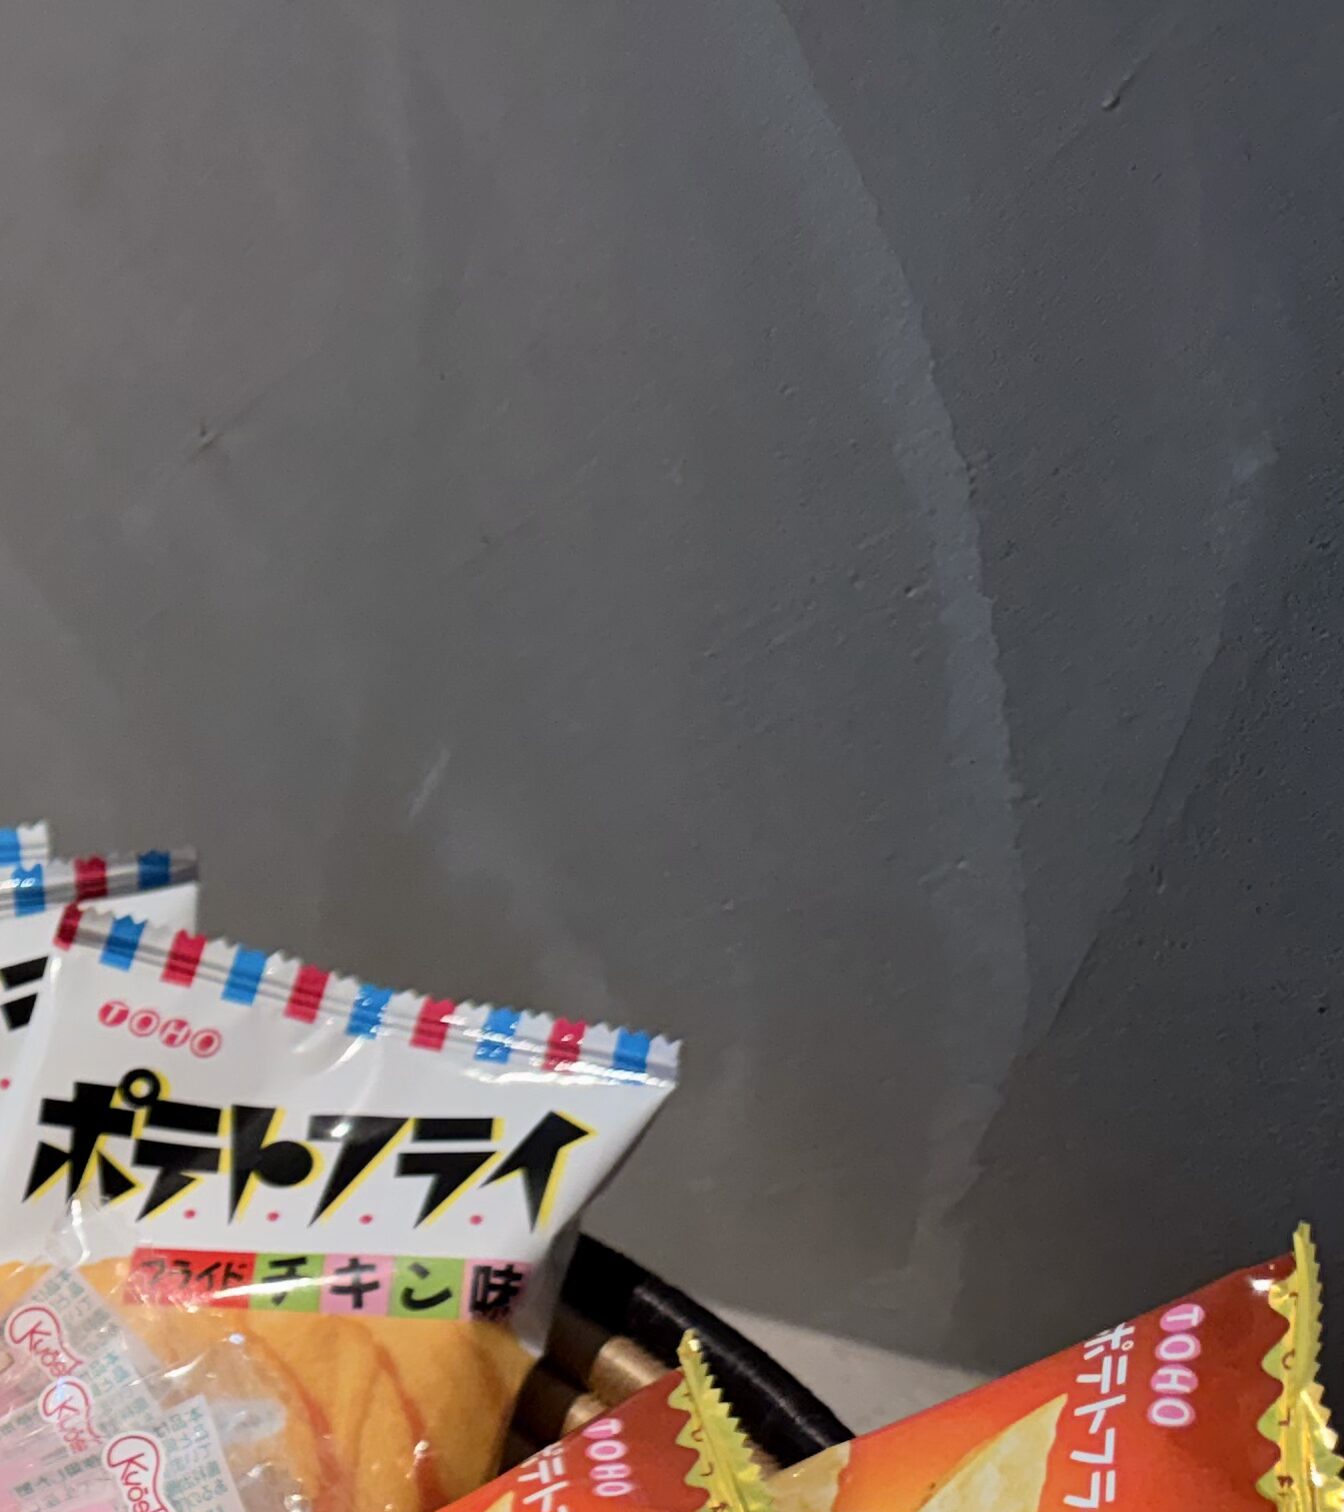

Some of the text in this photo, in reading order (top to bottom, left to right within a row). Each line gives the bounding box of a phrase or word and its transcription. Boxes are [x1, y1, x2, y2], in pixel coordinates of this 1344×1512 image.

[97, 1000, 223, 1058] TOHO
[21, 1068, 591, 1233] ポテトフライ
[1147, 1305, 1202, 1427] TOHO
[581, 1415, 635, 1494] TOHO
